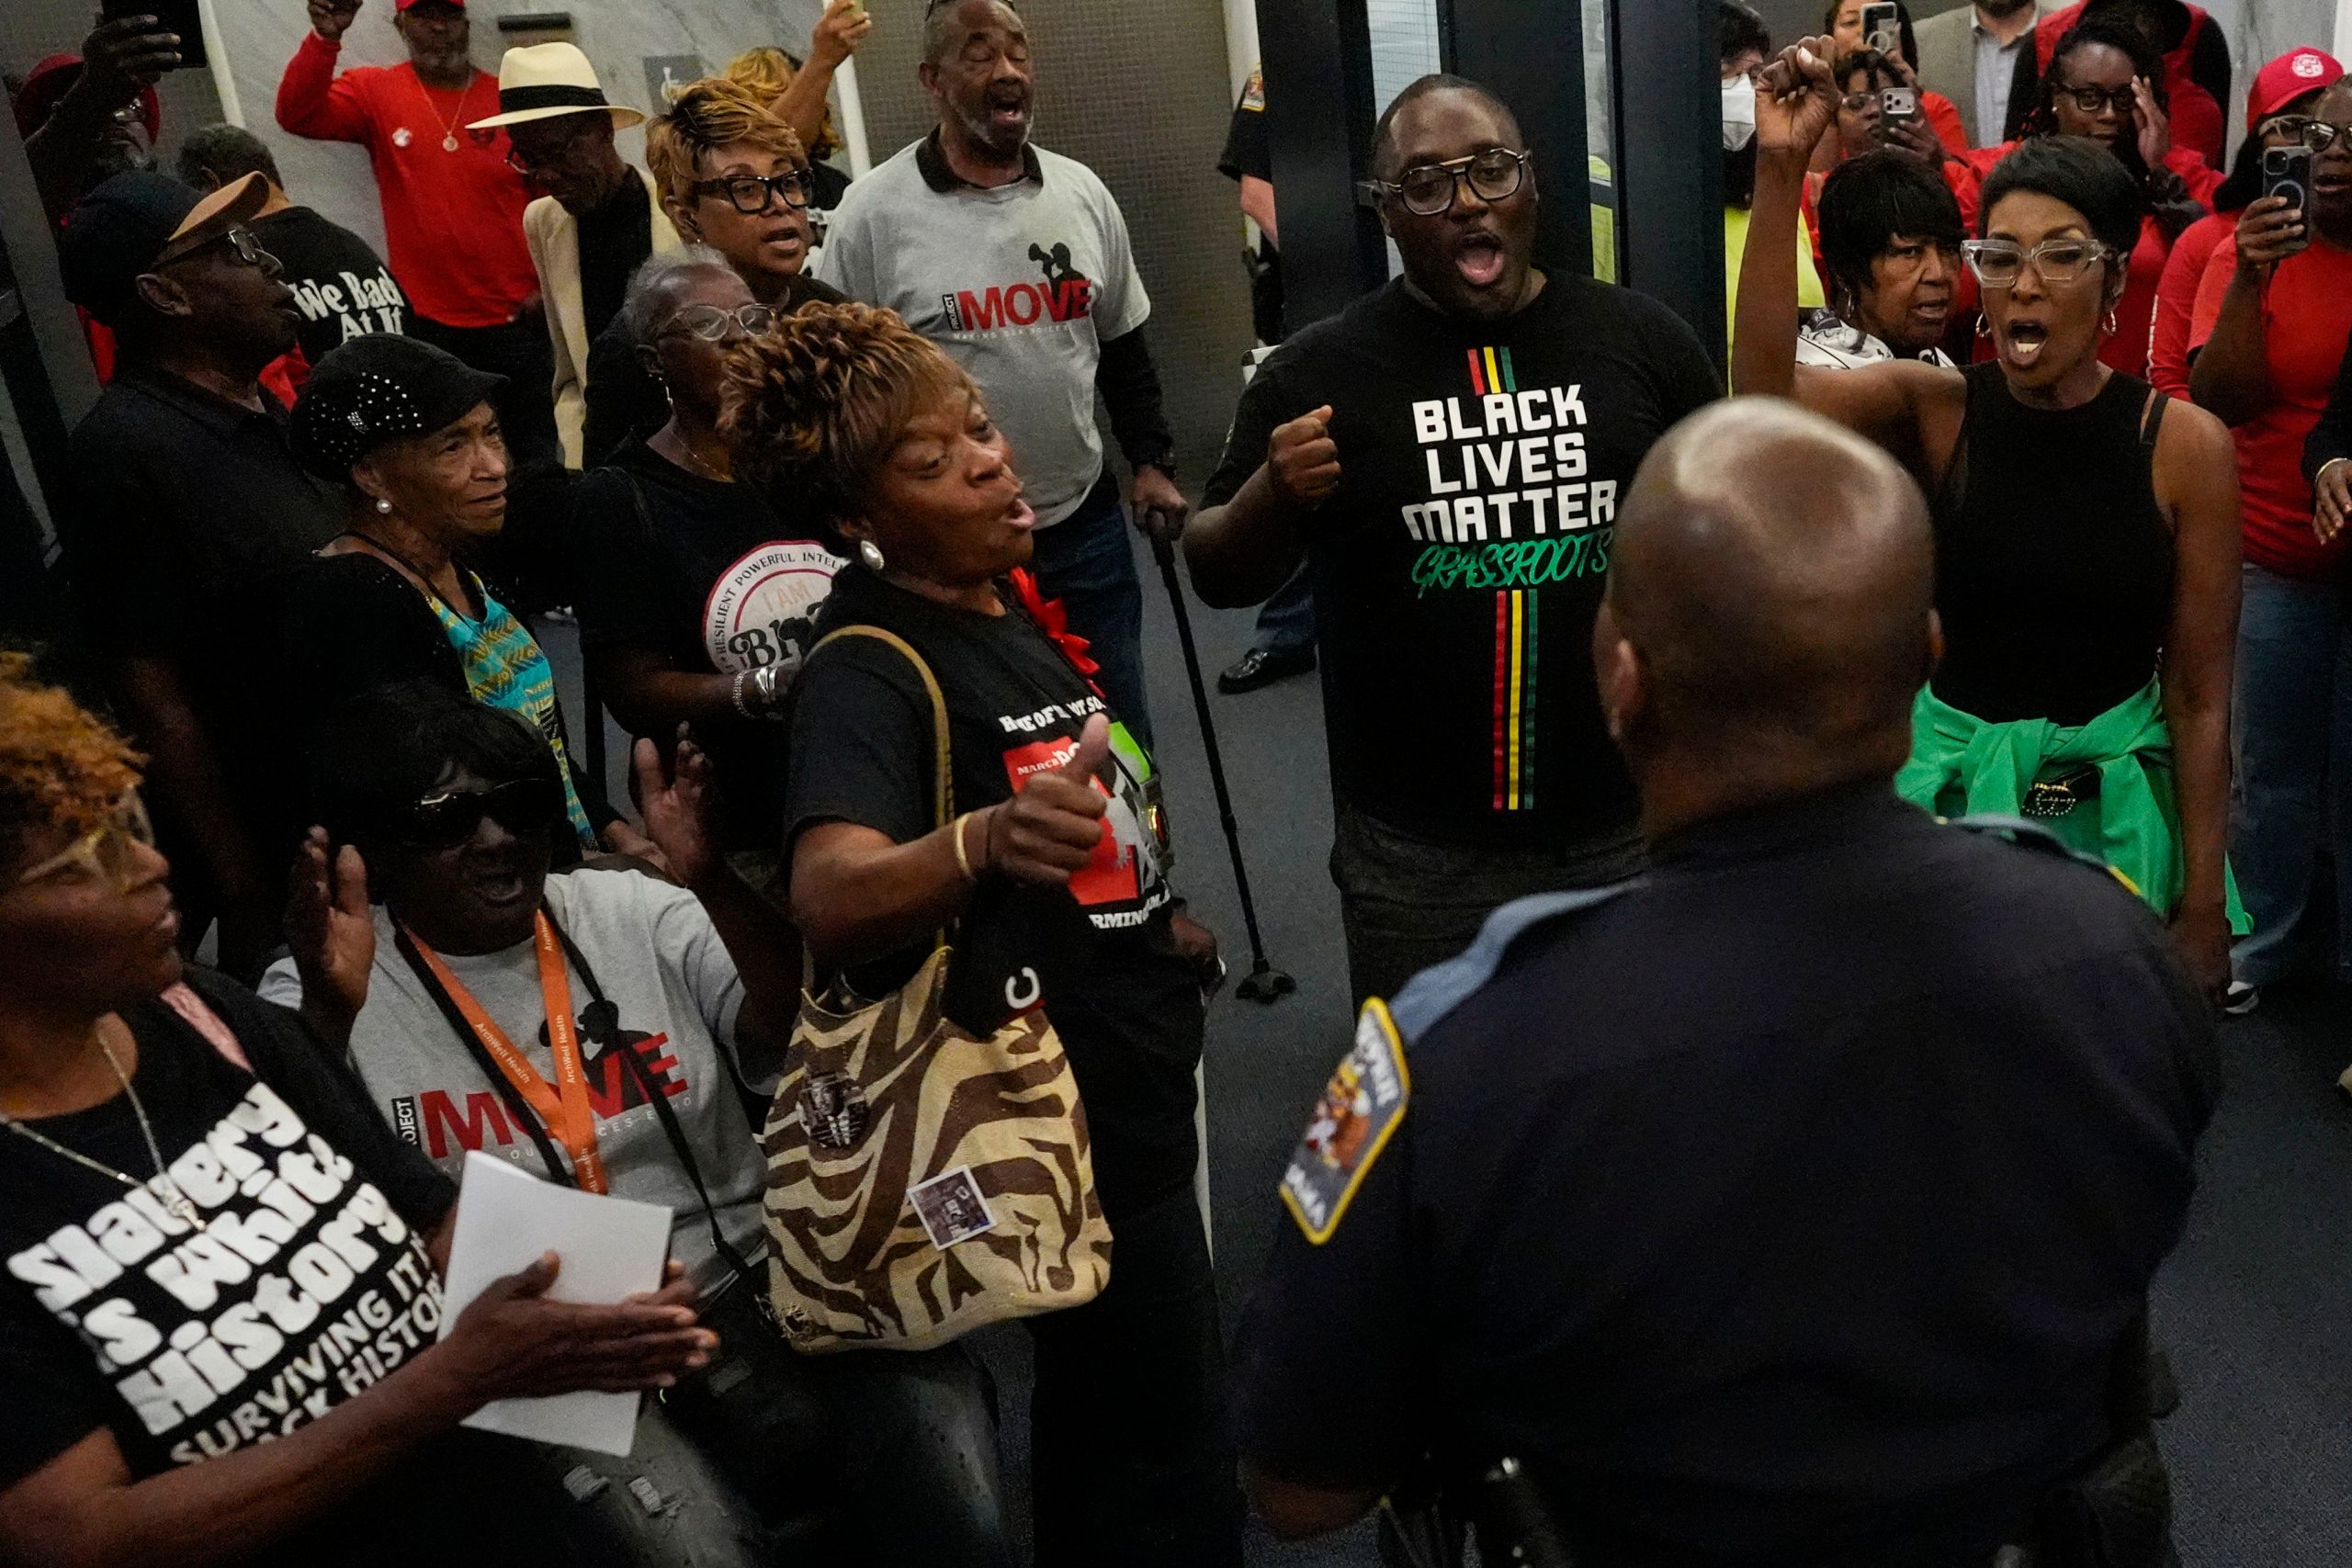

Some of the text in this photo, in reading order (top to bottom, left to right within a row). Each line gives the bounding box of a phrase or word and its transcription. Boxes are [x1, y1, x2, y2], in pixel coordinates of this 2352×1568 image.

[288, 278, 348, 321] We
[340, 306, 404, 345] At It
[957, 279, 1091, 331] MOVE
[1412, 384, 1588, 444] BLACK
[1426, 432, 1588, 494] LIVES
[1401, 479, 1617, 543] MATTER
[1411, 526, 1613, 599] GRASSROOTS
[714, 588, 737, 656] RESILIENT
[734, 553, 796, 587] POWERFUL
[476, 1022, 531, 1084] ArchWell Health
[555, 1013, 576, 1084] ArchWell Health
[396, 1100, 418, 1146] OJECT
[420, 1032, 688, 1159] MVE
[6, 1082, 306, 1313] Slavery
[115, 1183, 407, 1436] History
[170, 1289, 393, 1463] SURVIVING
[386, 1250, 423, 1303] IT
